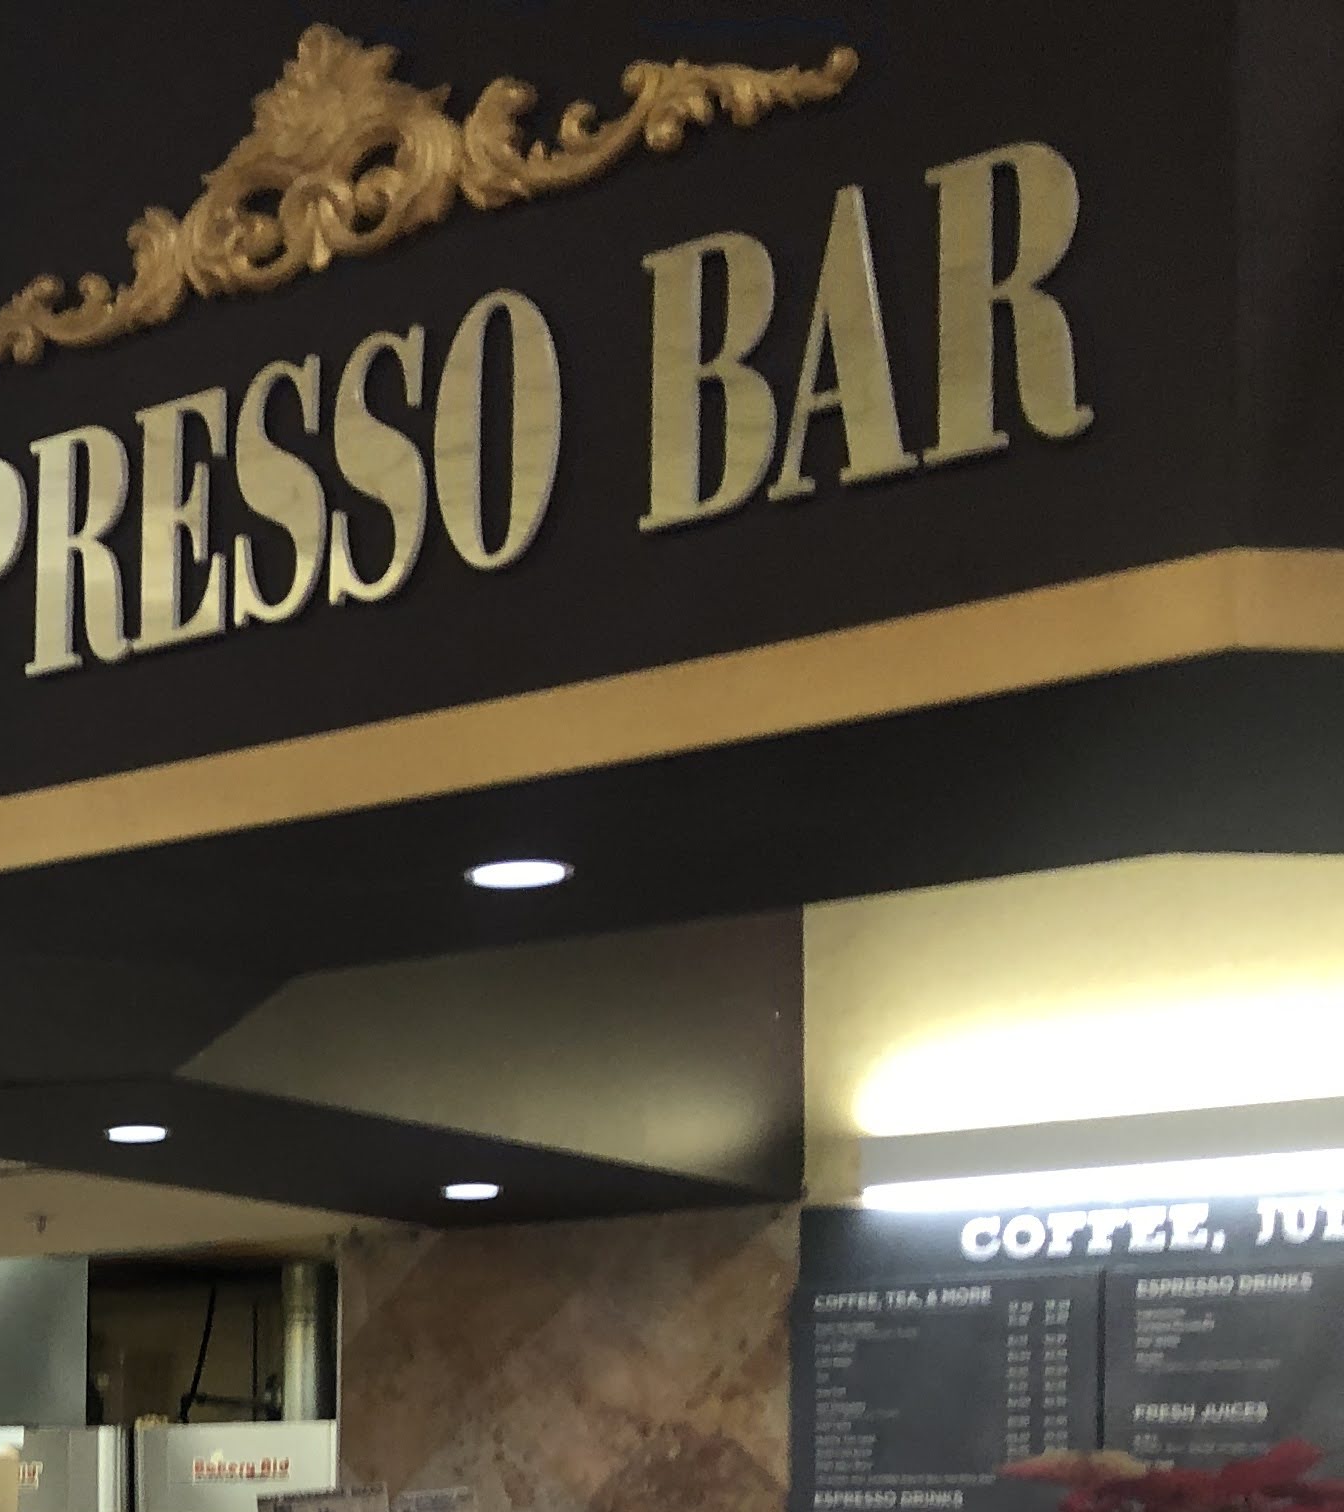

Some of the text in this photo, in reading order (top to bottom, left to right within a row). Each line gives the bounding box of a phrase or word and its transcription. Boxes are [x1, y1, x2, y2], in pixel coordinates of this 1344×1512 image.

[638, 141, 1095, 533] BAR
[960, 1203, 1226, 1264] COFFEE,
[1133, 1402, 1195, 1424] FRESH
